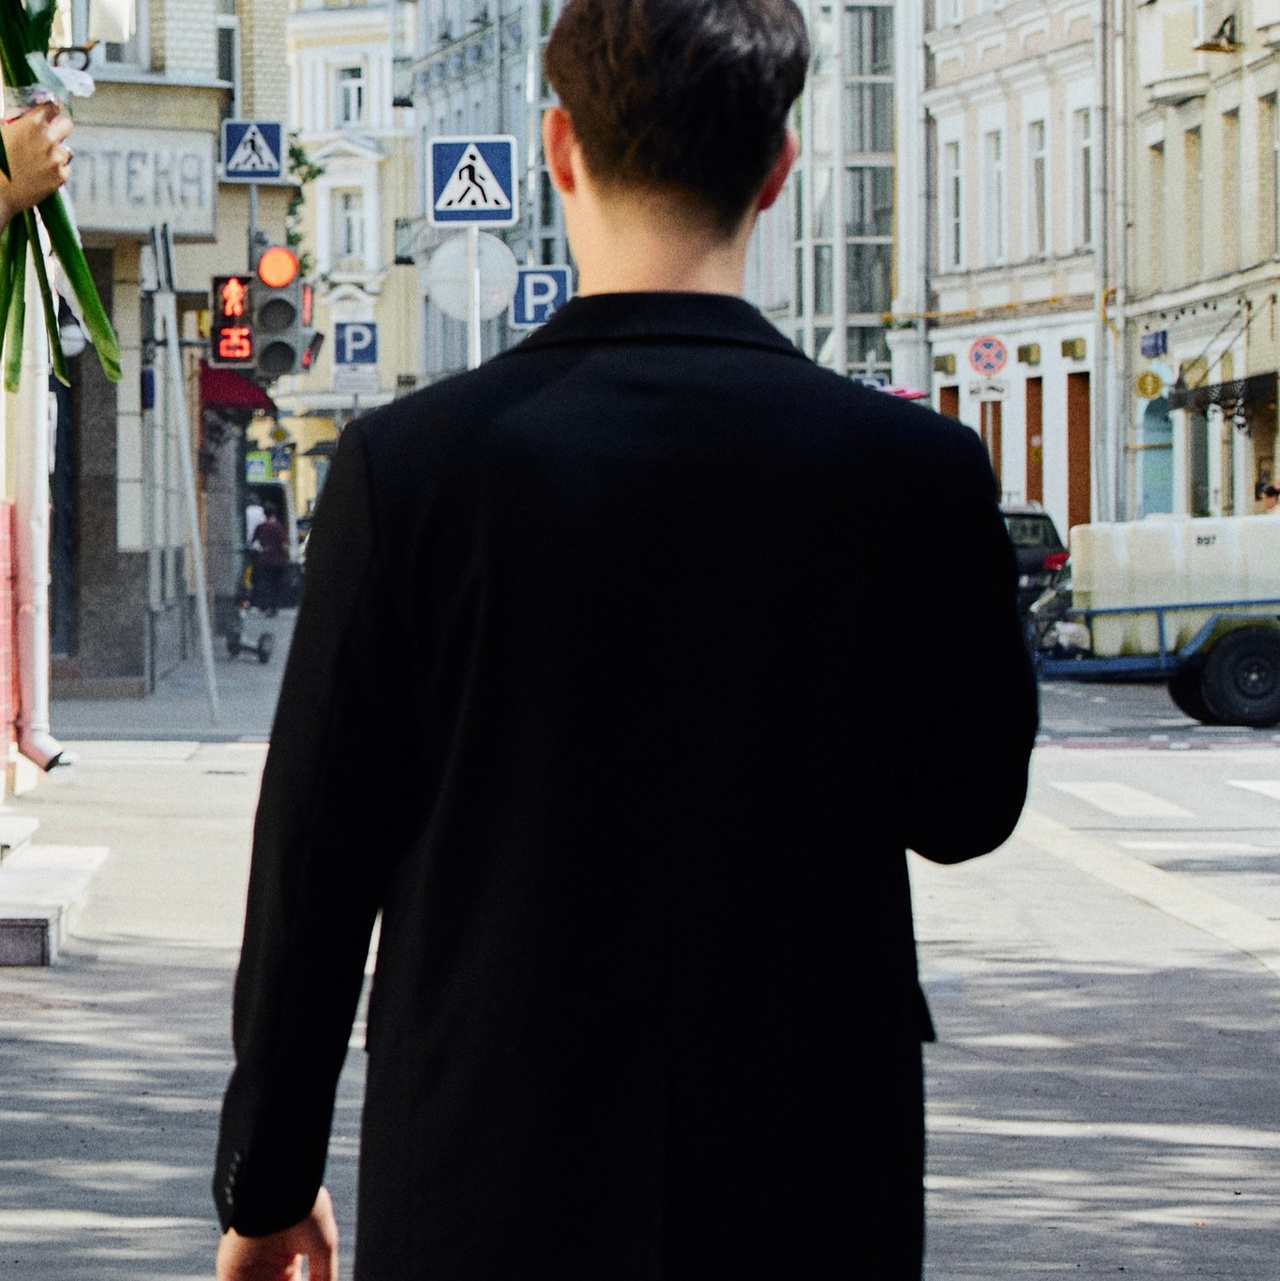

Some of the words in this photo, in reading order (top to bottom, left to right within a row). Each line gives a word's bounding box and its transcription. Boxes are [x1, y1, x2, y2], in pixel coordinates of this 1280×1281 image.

[71, 148, 204, 208] ПТЕКА
[524, 273, 558, 321] P
[345, 324, 372, 362] P
